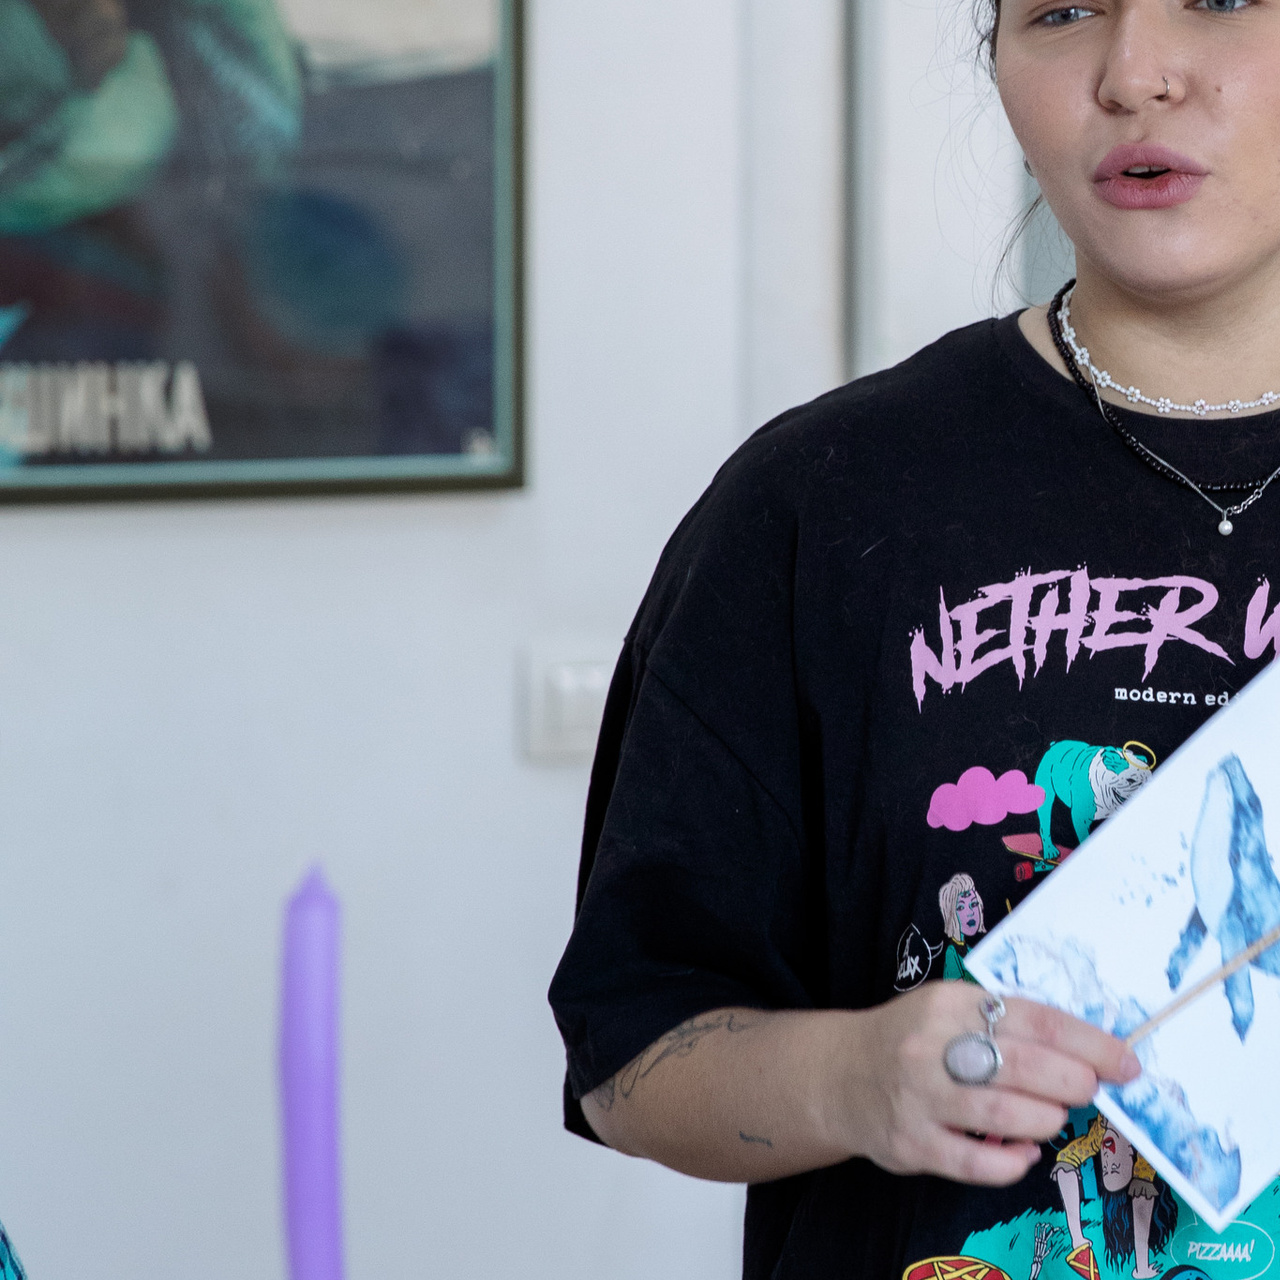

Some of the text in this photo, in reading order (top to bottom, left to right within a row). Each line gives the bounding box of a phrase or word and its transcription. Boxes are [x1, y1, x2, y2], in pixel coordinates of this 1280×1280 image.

[910, 561, 1237, 714] NETHER
[1114, 686, 1197, 705] modern
[1187, 1239, 1255, 1263] PIZZAAAA!
